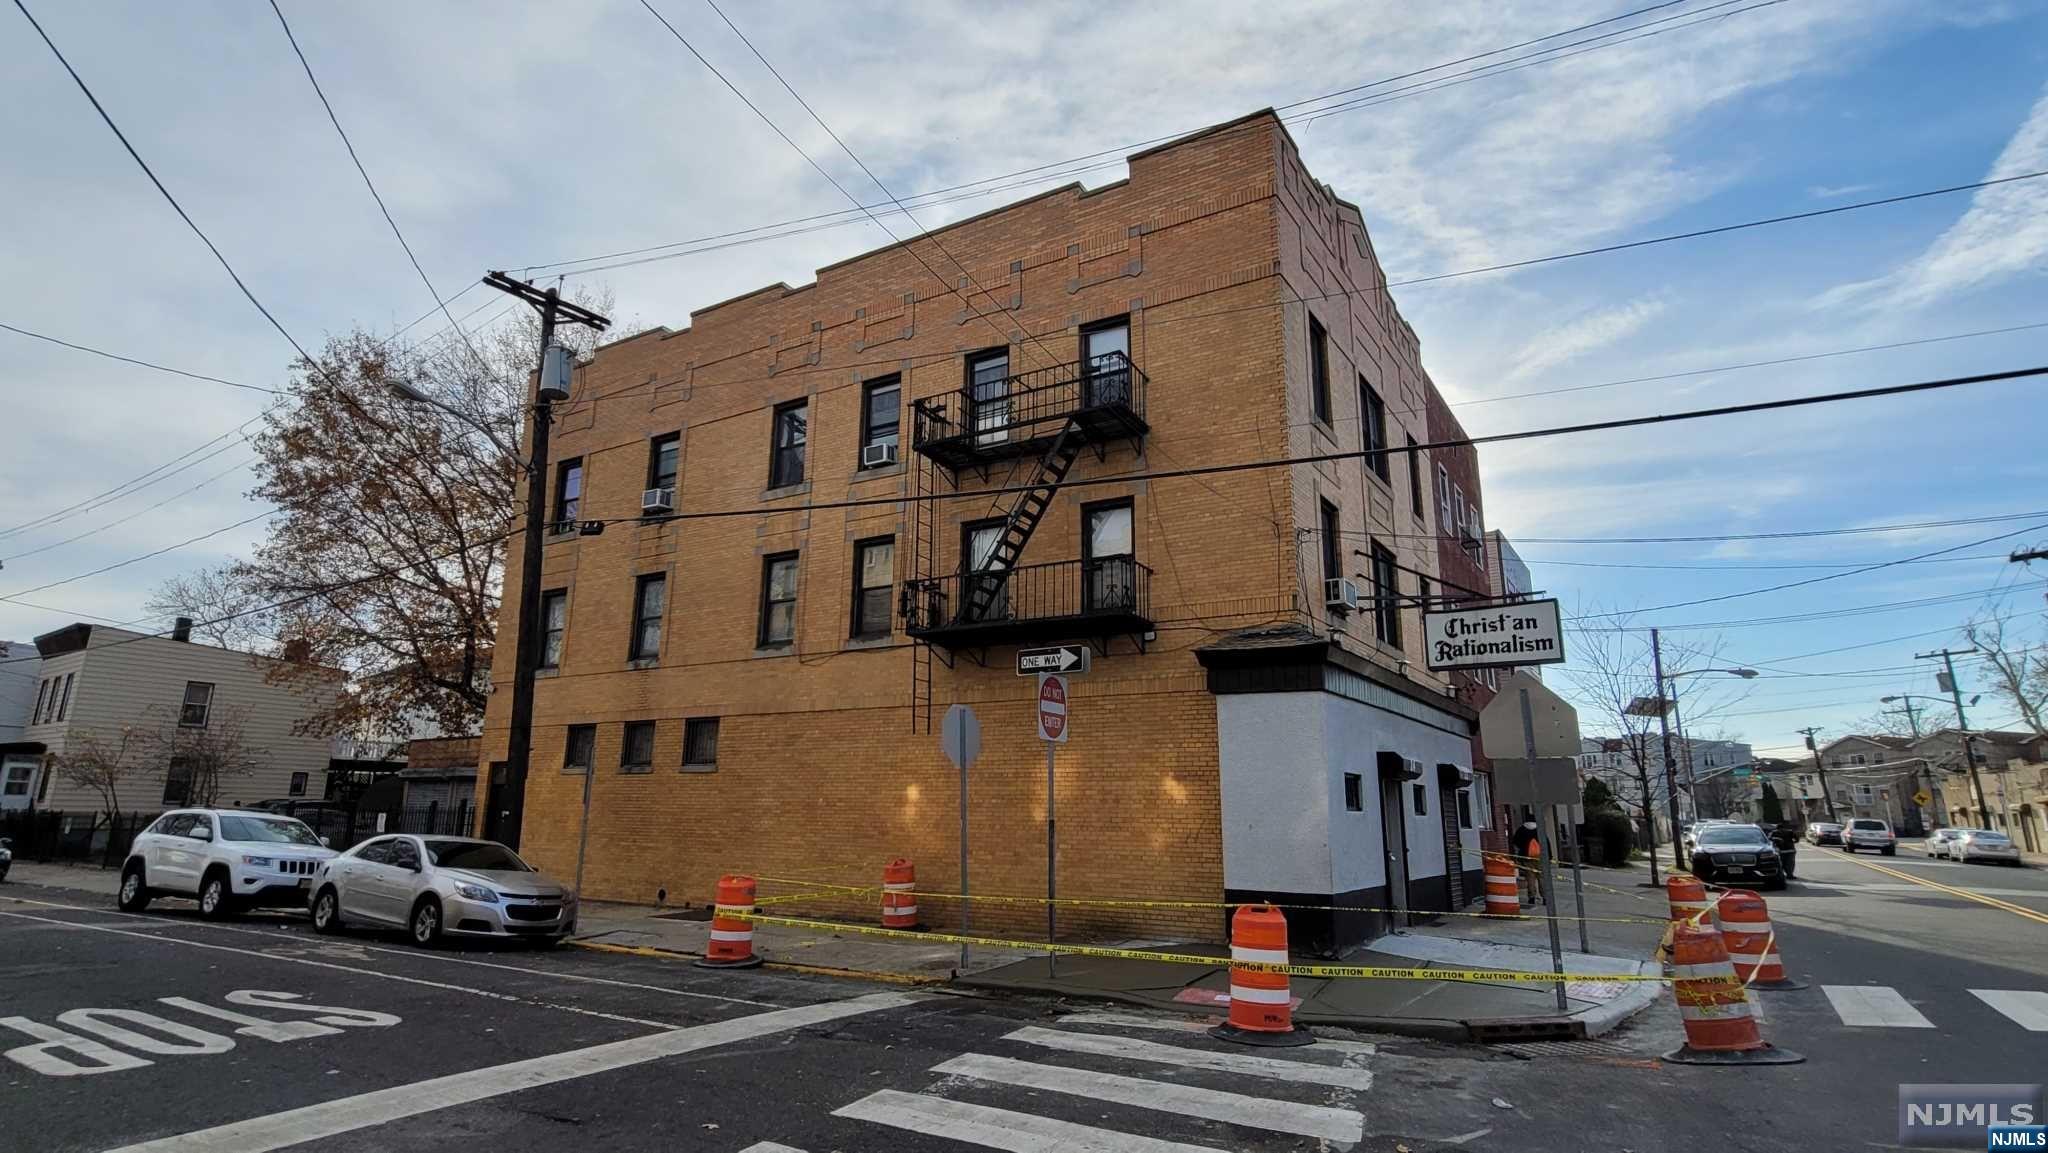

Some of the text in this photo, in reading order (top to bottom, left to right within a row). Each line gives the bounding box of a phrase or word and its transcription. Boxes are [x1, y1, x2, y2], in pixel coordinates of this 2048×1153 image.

[1444, 614, 1538, 639] Christan
[1434, 634, 1554, 662] Rationalism
[1022, 655, 1062, 667] ONE WAY
[1043, 686, 1062, 700] DO NOT
[1044, 715, 1062, 728] ENTER
[1089, 949, 1121, 957] CAUTION
[1128, 951, 1162, 960] CAUTION
[1271, 965, 1313, 974] CAUTION
[1321, 968, 1363, 976] CAUTION
[1371, 969, 1414, 977] CAUTION
[1422, 971, 1464, 979] CAUTION
[1472, 972, 1516, 980] CAUTION
[0, 989, 402, 1076] STOP
